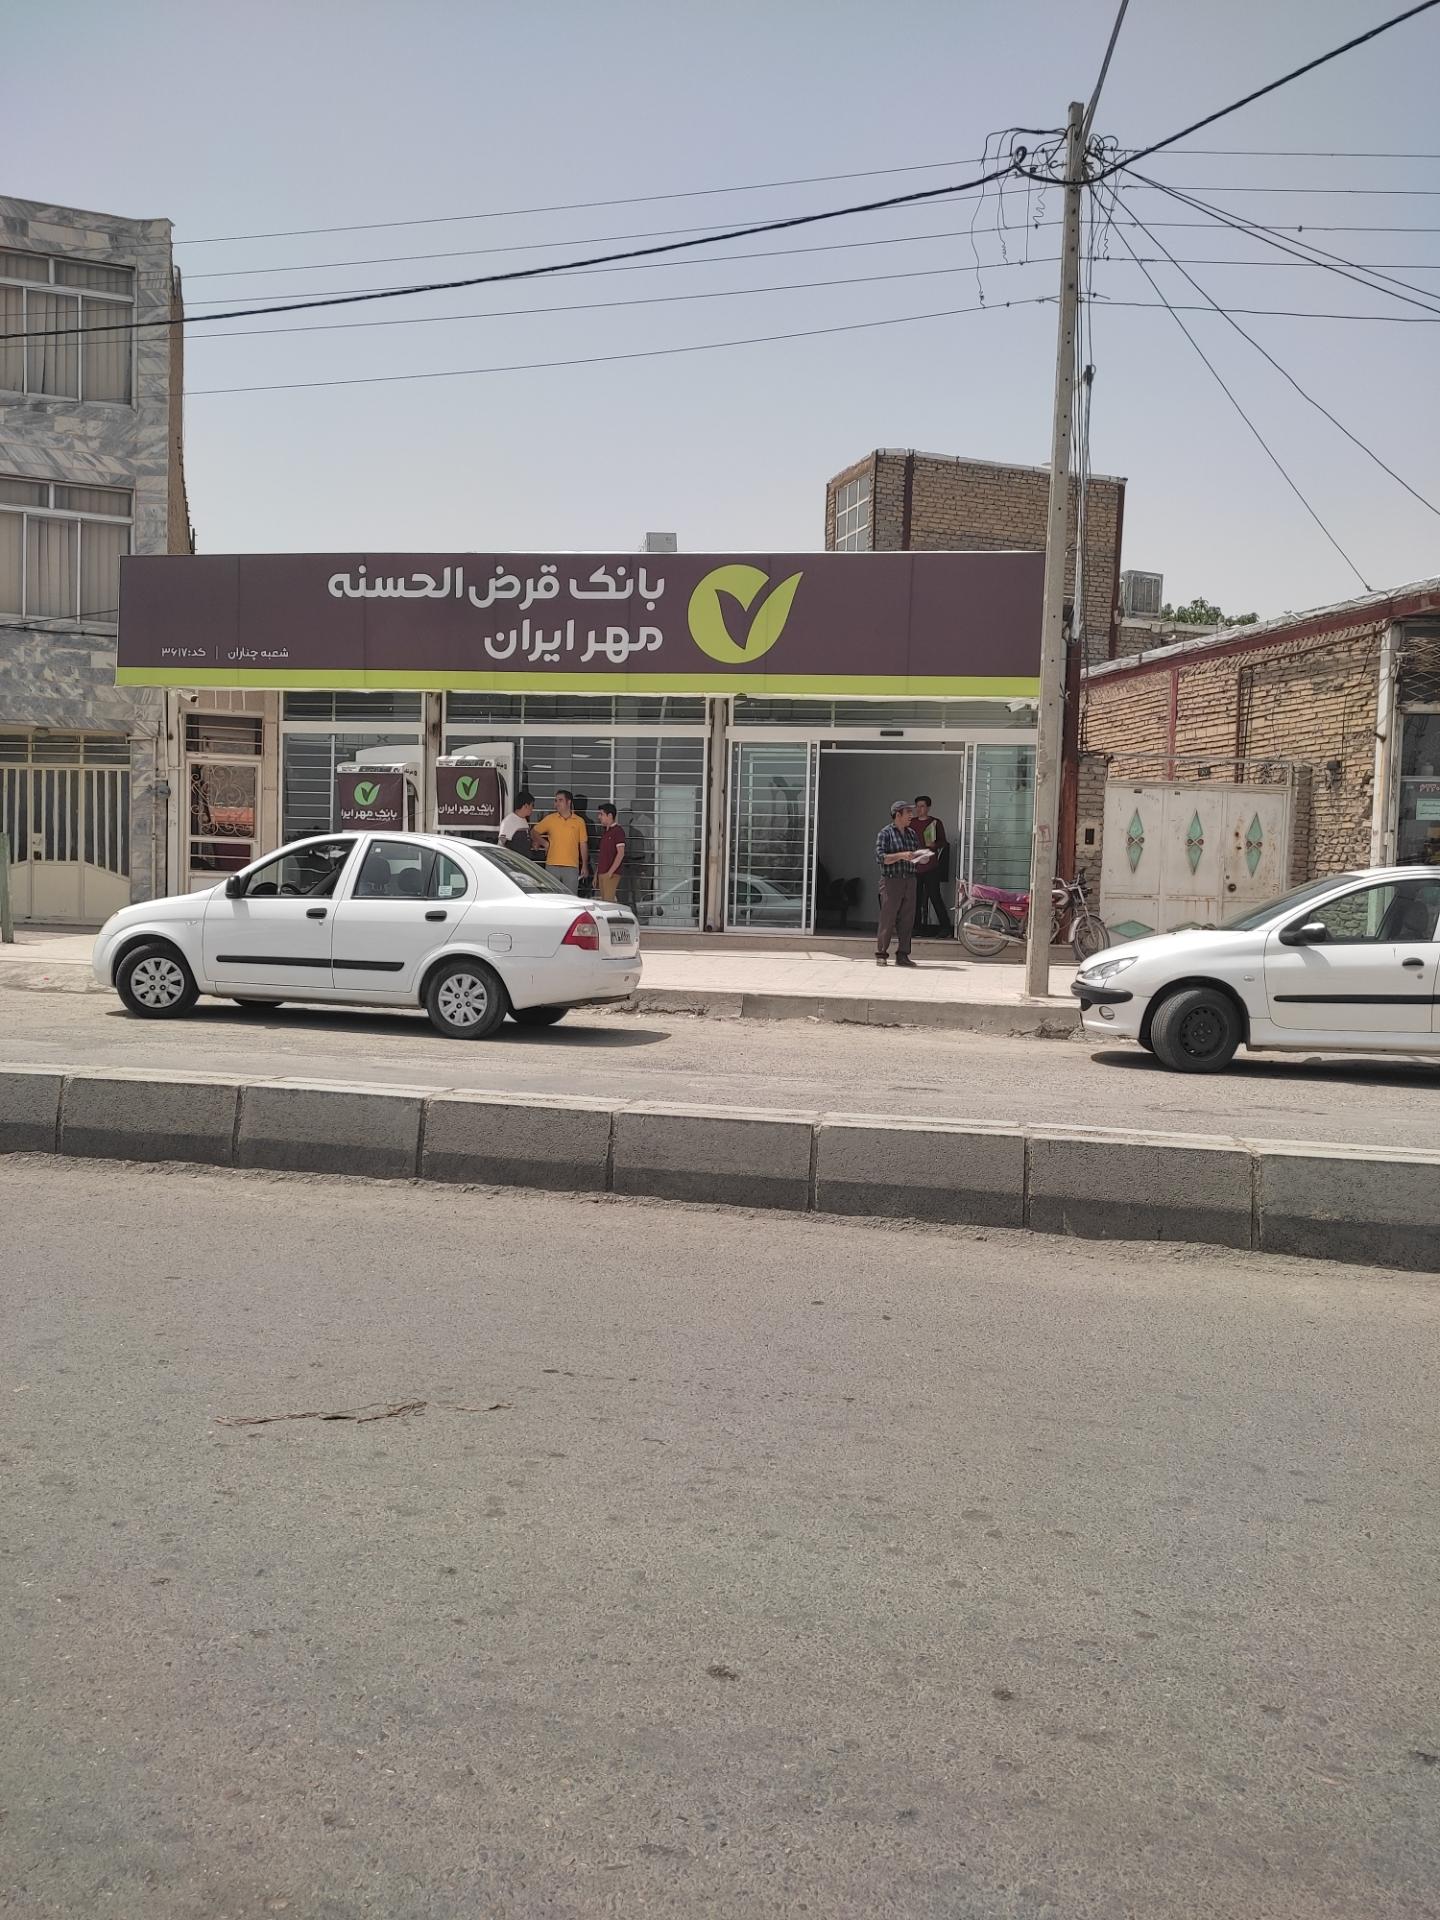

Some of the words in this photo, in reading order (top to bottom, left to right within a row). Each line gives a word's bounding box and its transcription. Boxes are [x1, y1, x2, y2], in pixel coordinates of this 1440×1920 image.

[327, 565, 464, 598] الحسنه
[469, 564, 560, 611] قرض
[569, 564, 665, 611] بانک
[484, 618, 575, 663] ایران
[580, 626, 663, 664] مهر
[227, 647, 259, 661] چناران
[260, 647, 289, 661] شعبه
[341, 808, 354, 820] ایرا
[354, 809, 374, 820] مهر
[374, 808, 398, 821] بانک
[438, 803, 457, 815] ایران
[458, 804, 476, 815] مهر
[477, 803, 495, 815] بانک
